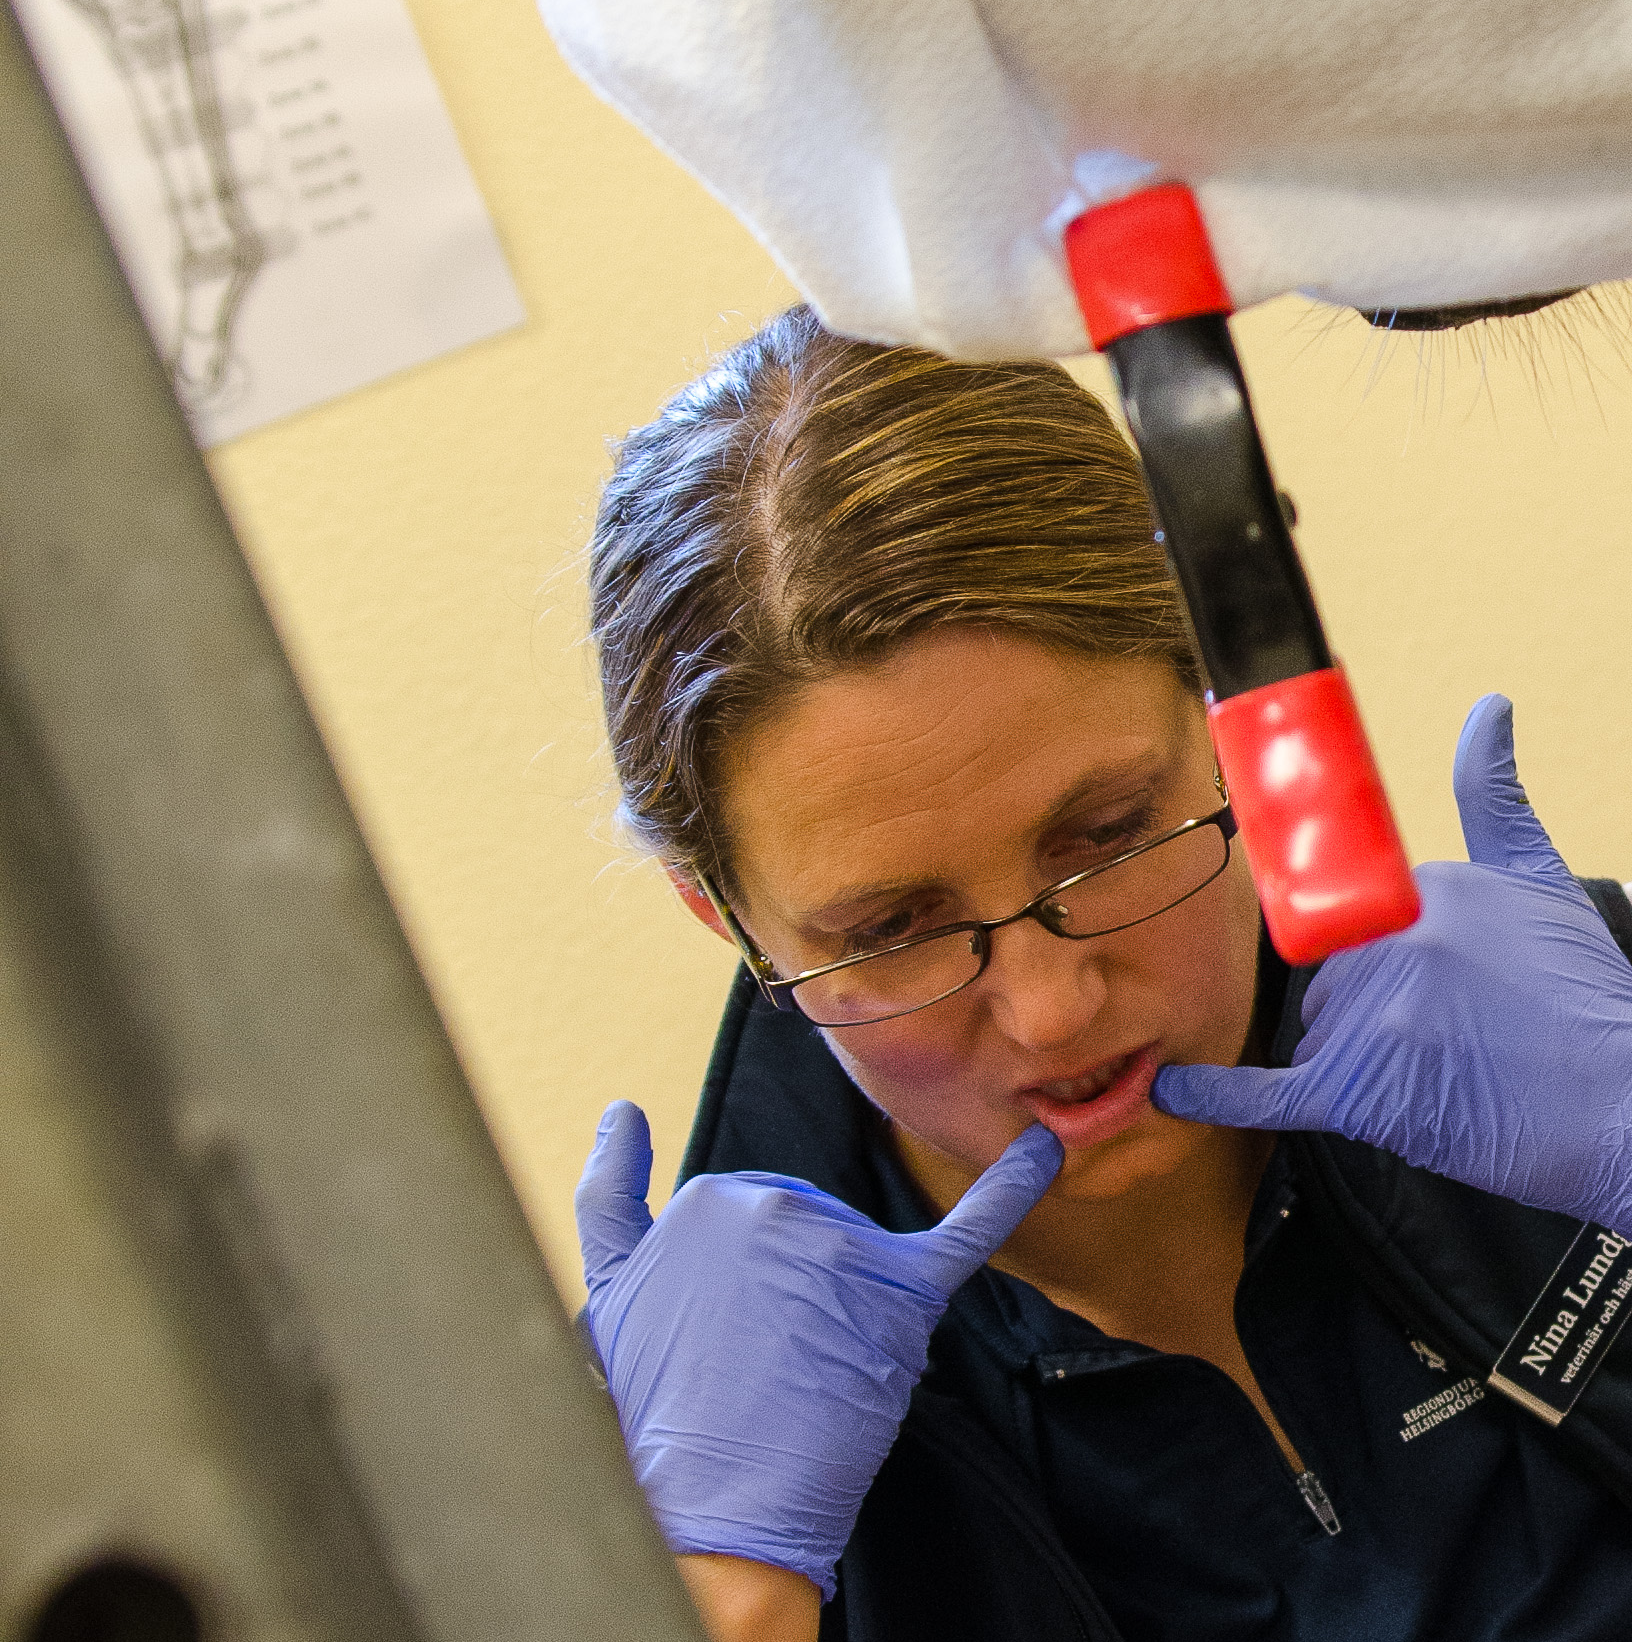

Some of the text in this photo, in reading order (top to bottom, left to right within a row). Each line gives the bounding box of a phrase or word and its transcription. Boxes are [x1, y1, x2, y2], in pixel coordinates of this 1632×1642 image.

[1519, 1309, 1579, 1377] Nina
[1560, 1323, 1604, 1383] veterinär
[1600, 1298, 1621, 1325] och
[1399, 1387, 1485, 1442] HELSINGBORG
